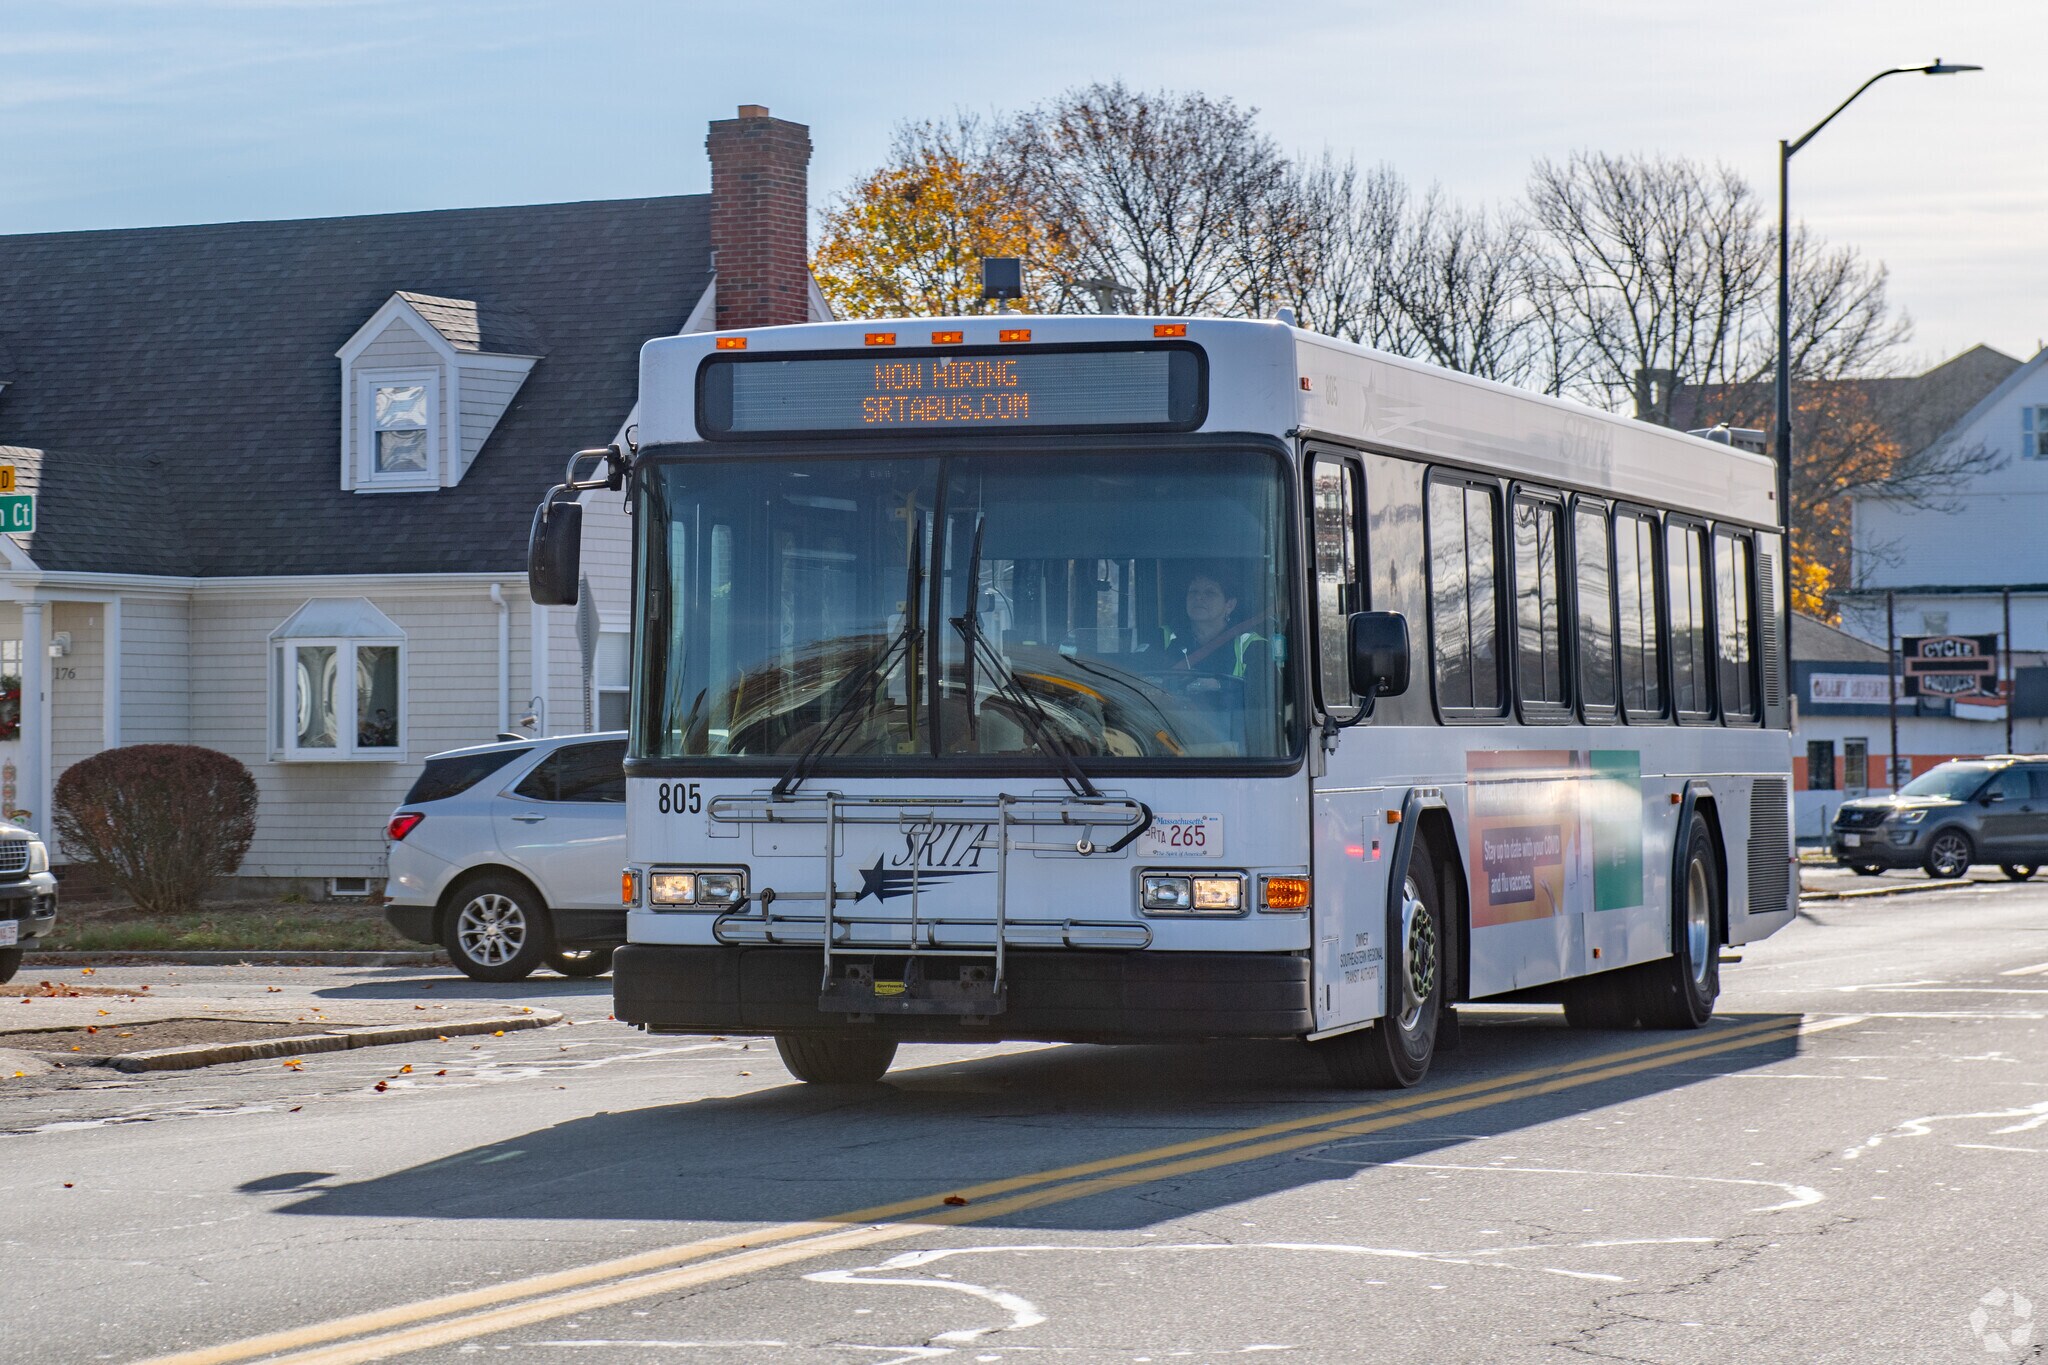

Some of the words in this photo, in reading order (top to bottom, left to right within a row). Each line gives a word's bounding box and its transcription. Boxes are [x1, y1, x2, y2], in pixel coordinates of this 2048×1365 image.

[875, 363, 921, 390] NOW
[933, 360, 1017, 388] HIRING
[863, 393, 1029, 423] SRTABUS.COM
[2, 470, 9, 488] D
[13, 502, 30, 527] Ct
[1924, 640, 1973, 658] CYCLE
[55, 667, 76, 680] 176
[658, 783, 702, 814] 805
[1156, 817, 1204, 825] Massachusetts
[890, 822, 990, 867] SRTA
[1171, 825, 1206, 847] 265
[1484, 840, 1496, 865] Stay
[1510, 838, 1522, 858] date
[1544, 835, 1560, 855] COVID
